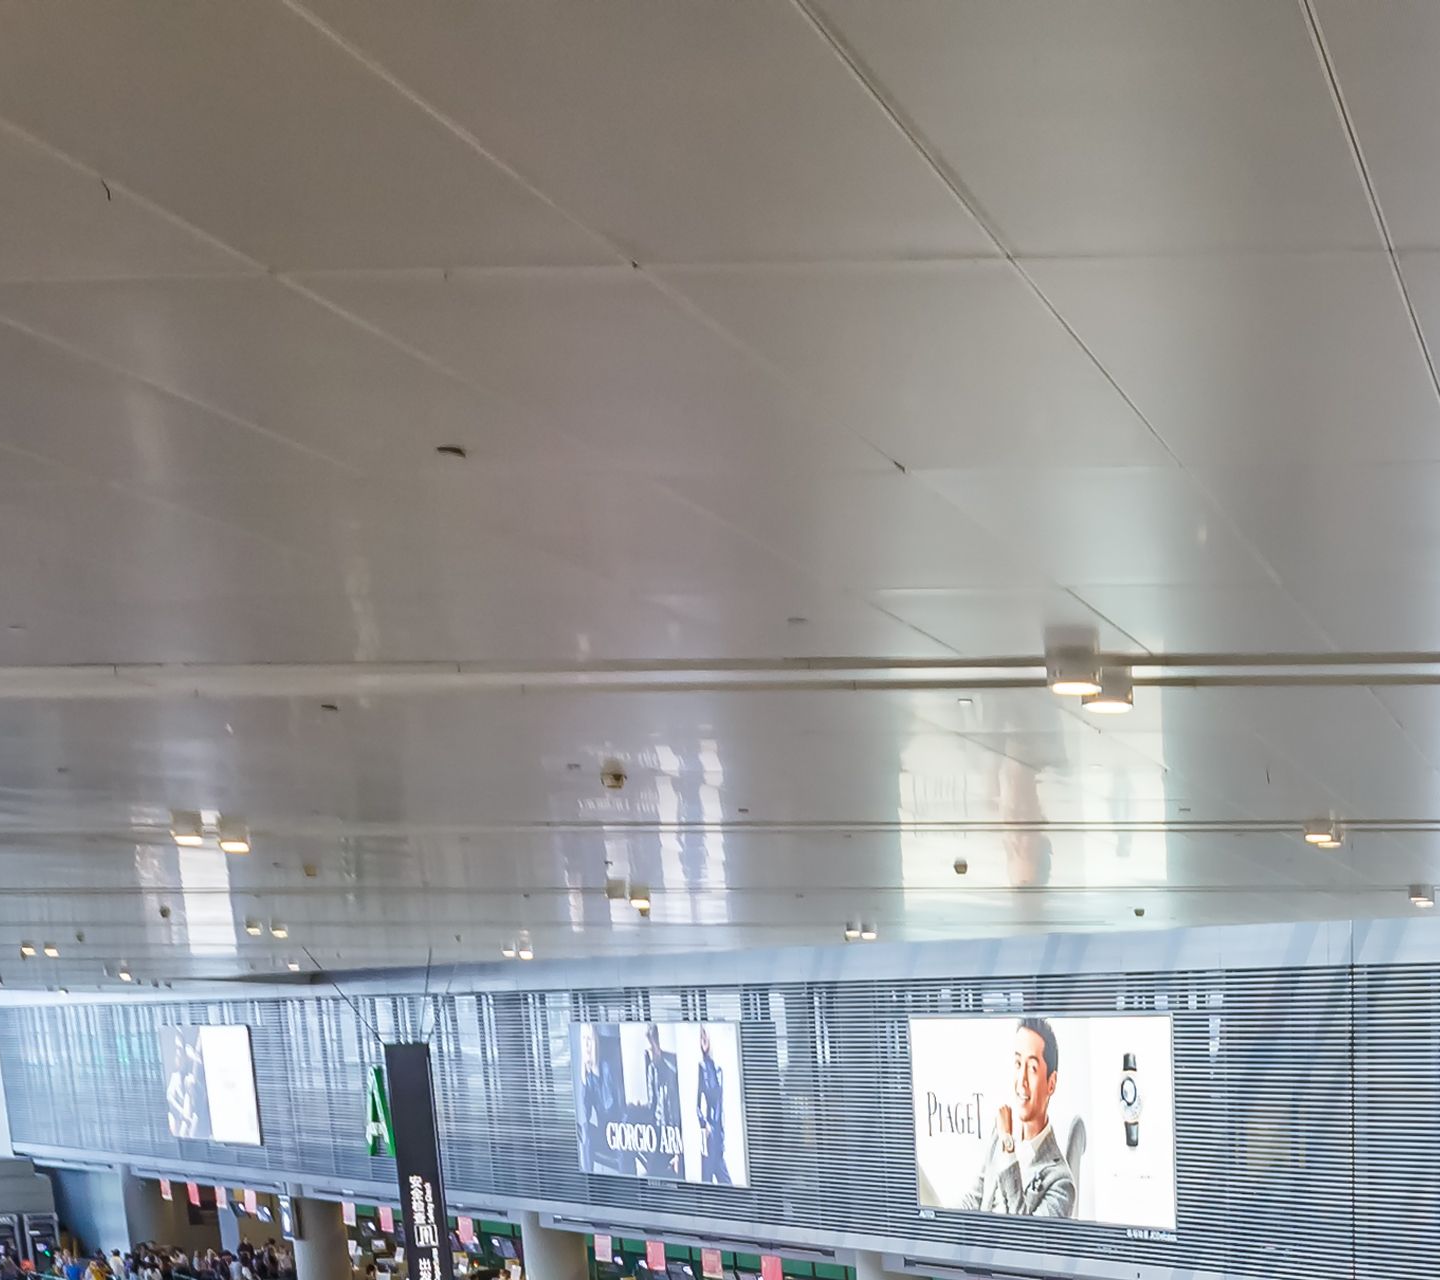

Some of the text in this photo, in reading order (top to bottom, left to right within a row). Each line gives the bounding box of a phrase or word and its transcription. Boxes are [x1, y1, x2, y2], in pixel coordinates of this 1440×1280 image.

[366, 1064, 396, 1158] A
[927, 1092, 984, 1139] PIAGET
[606, 1122, 657, 1152] GIORGIO
